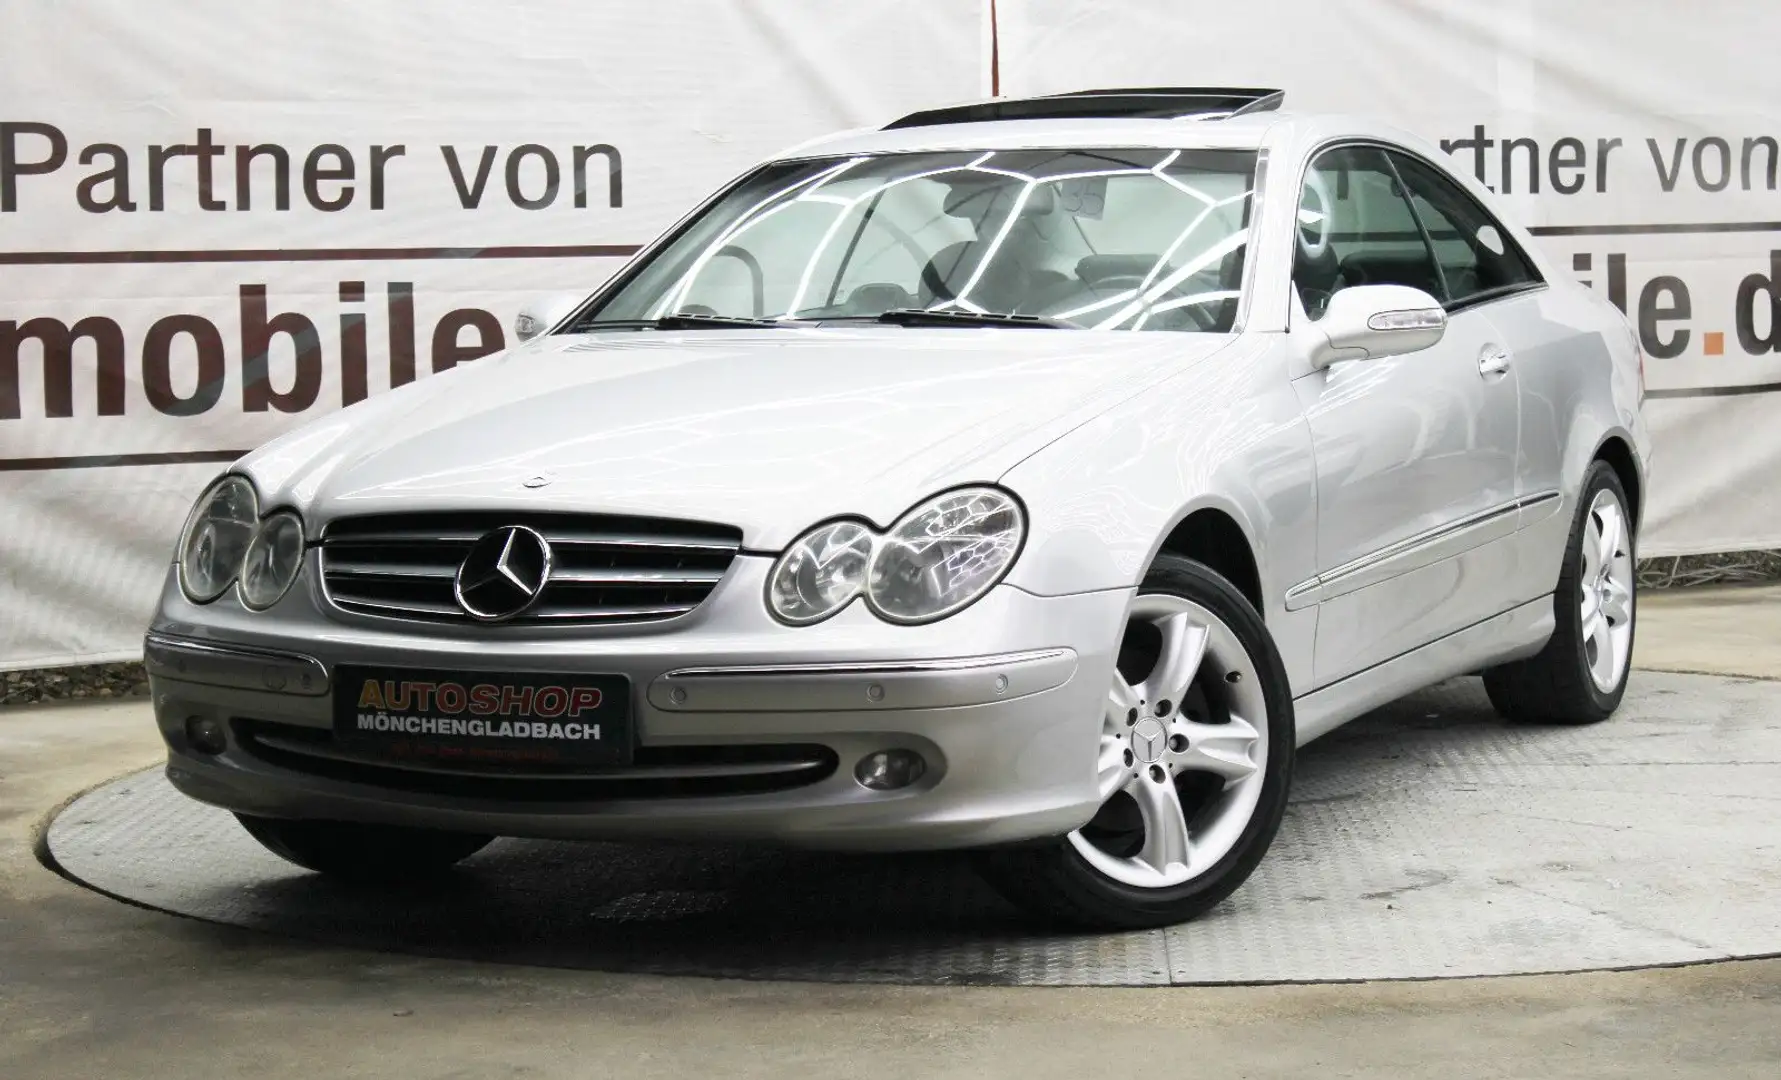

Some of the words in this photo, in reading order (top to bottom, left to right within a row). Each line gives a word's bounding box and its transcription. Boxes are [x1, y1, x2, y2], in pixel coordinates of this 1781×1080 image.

[0, 121, 405, 213] Partner
[440, 142, 624, 211] von
[1646, 135, 1779, 193] von
[357, 679, 602, 718] AUTOSHOP
[357, 711, 601, 740] MÖNCHENGLADBACH
